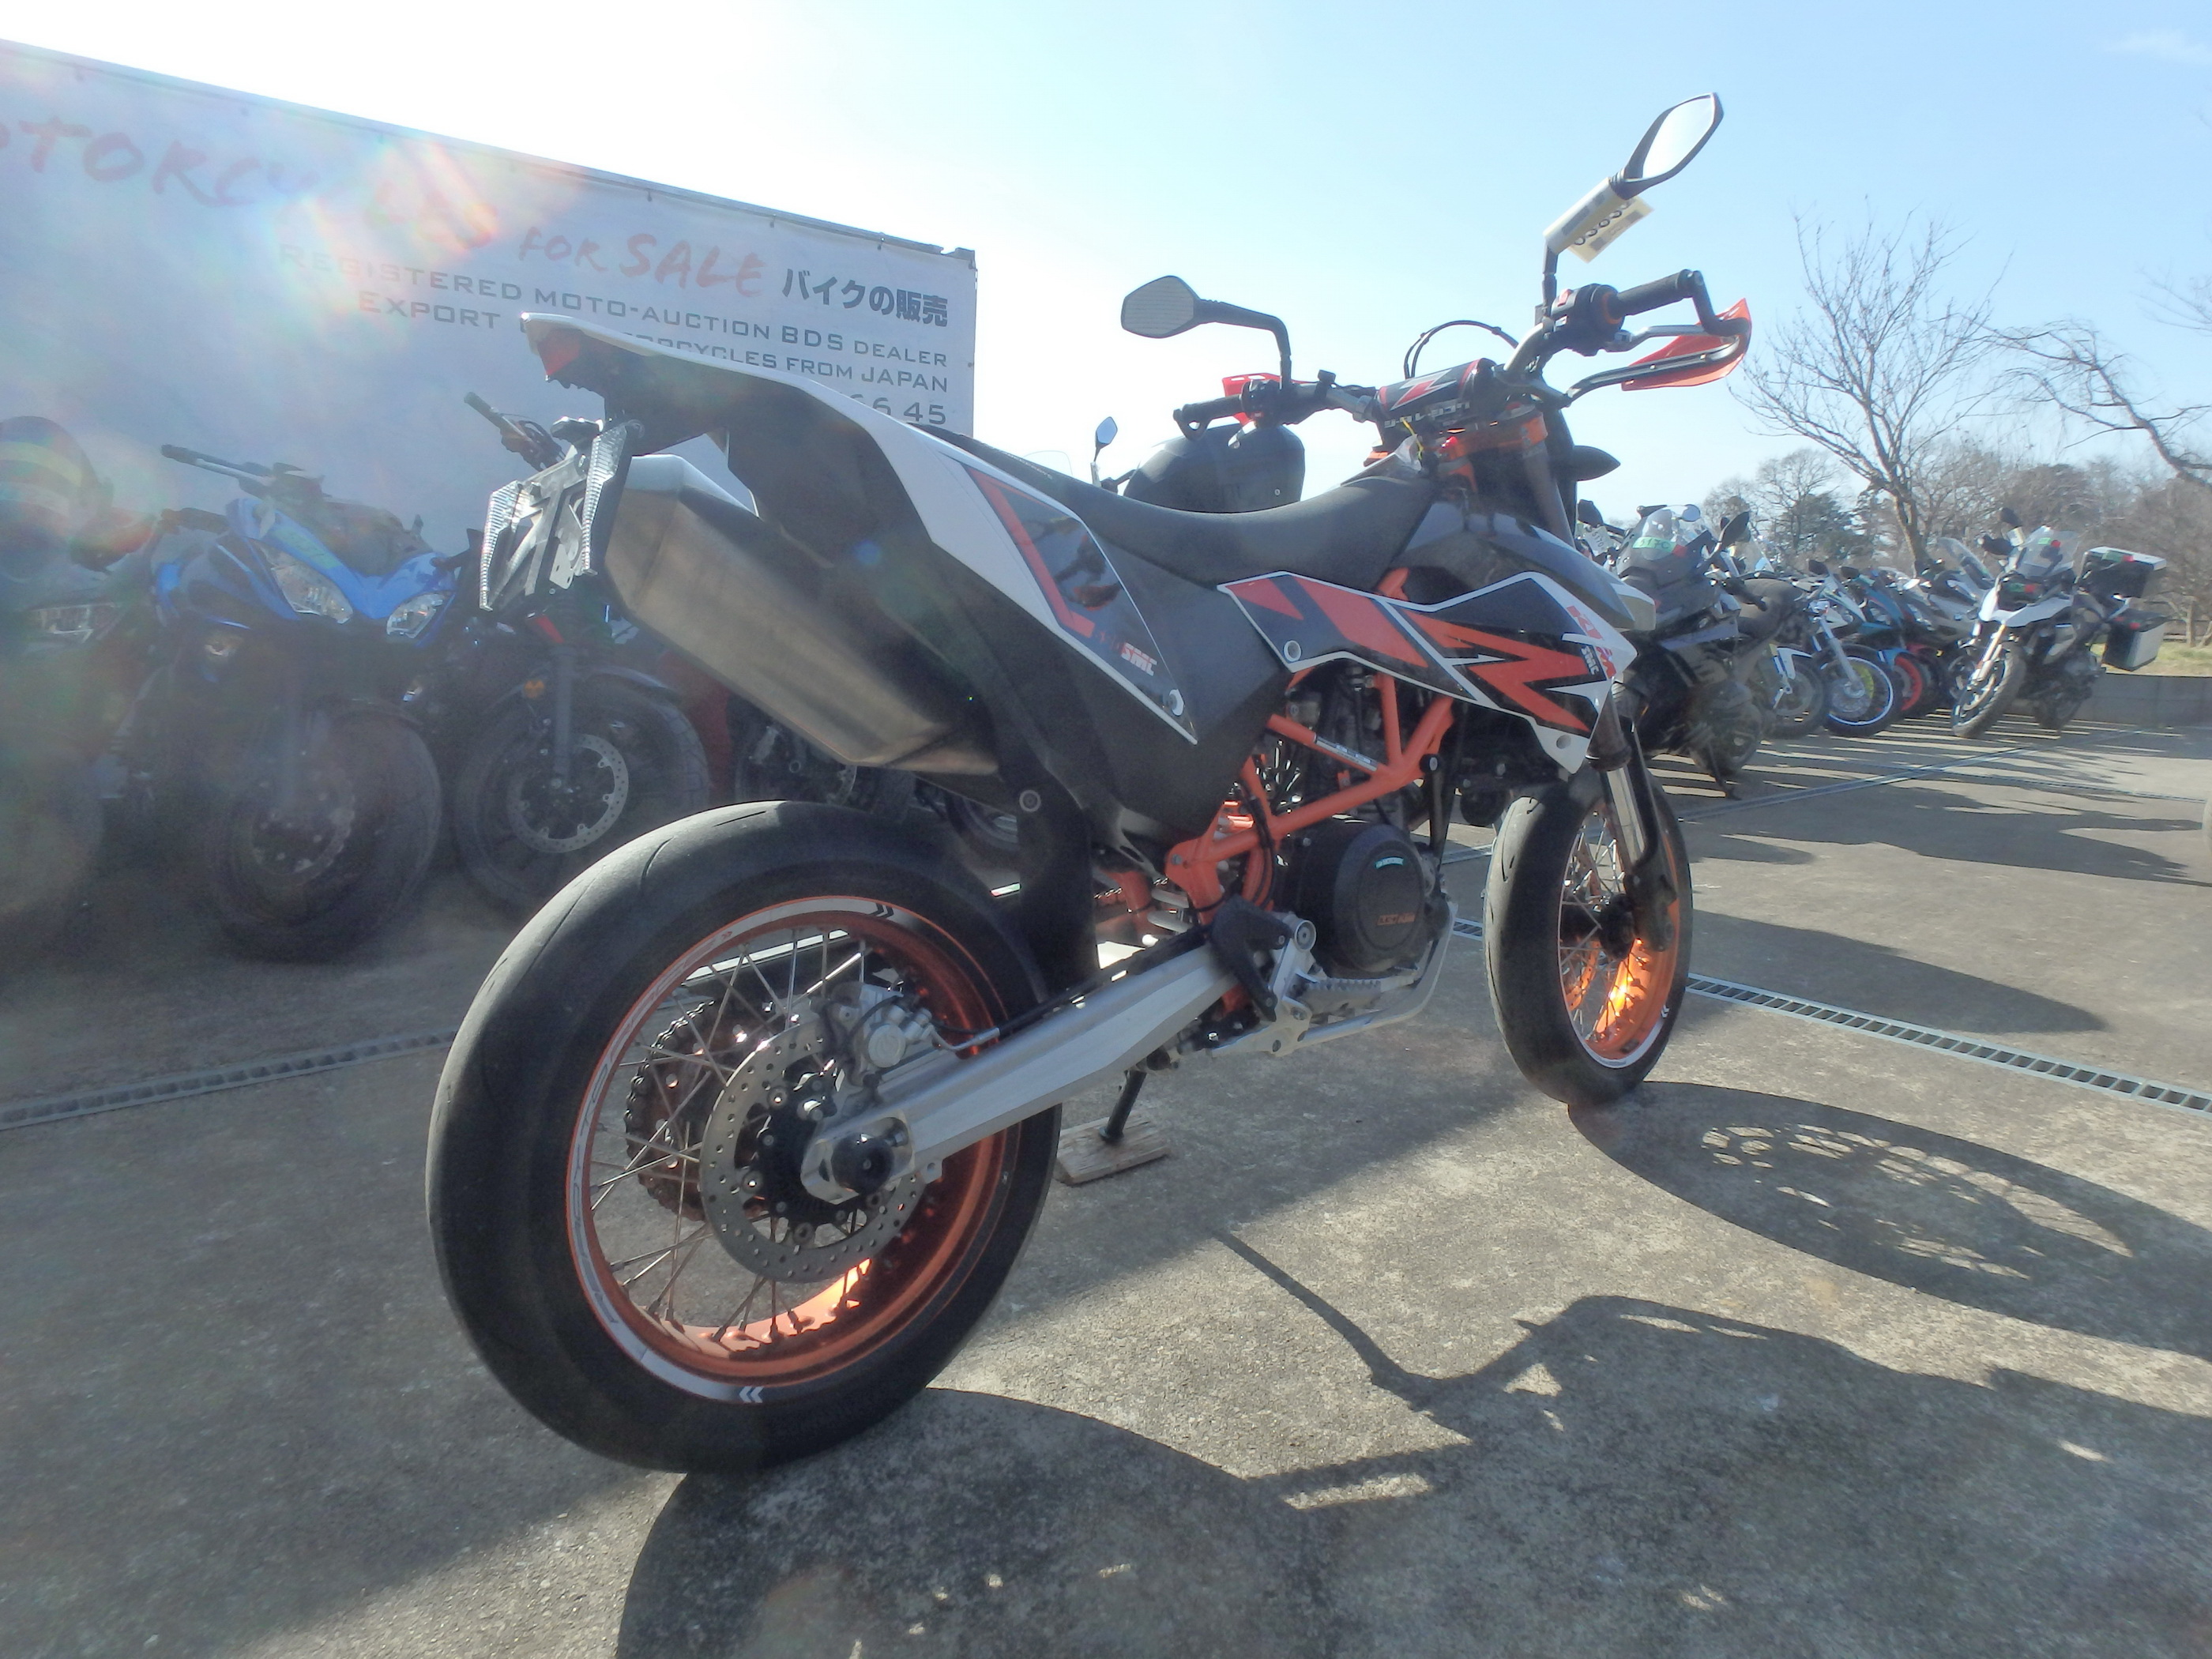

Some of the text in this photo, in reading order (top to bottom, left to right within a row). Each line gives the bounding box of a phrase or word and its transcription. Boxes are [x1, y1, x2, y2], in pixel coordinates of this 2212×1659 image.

[518, 227, 609, 272] FOR
[619, 233, 766, 297] SALE
[279, 243, 947, 367] REGISTERED MOTO-AUCTION BDS DEALER
[781, 268, 948, 327] バイクの販売
[359, 291, 501, 329] EXPORT
[786, 357, 852, 380] FROM
[861, 367, 947, 393] JAPAN
[903, 402, 946, 425] 45
